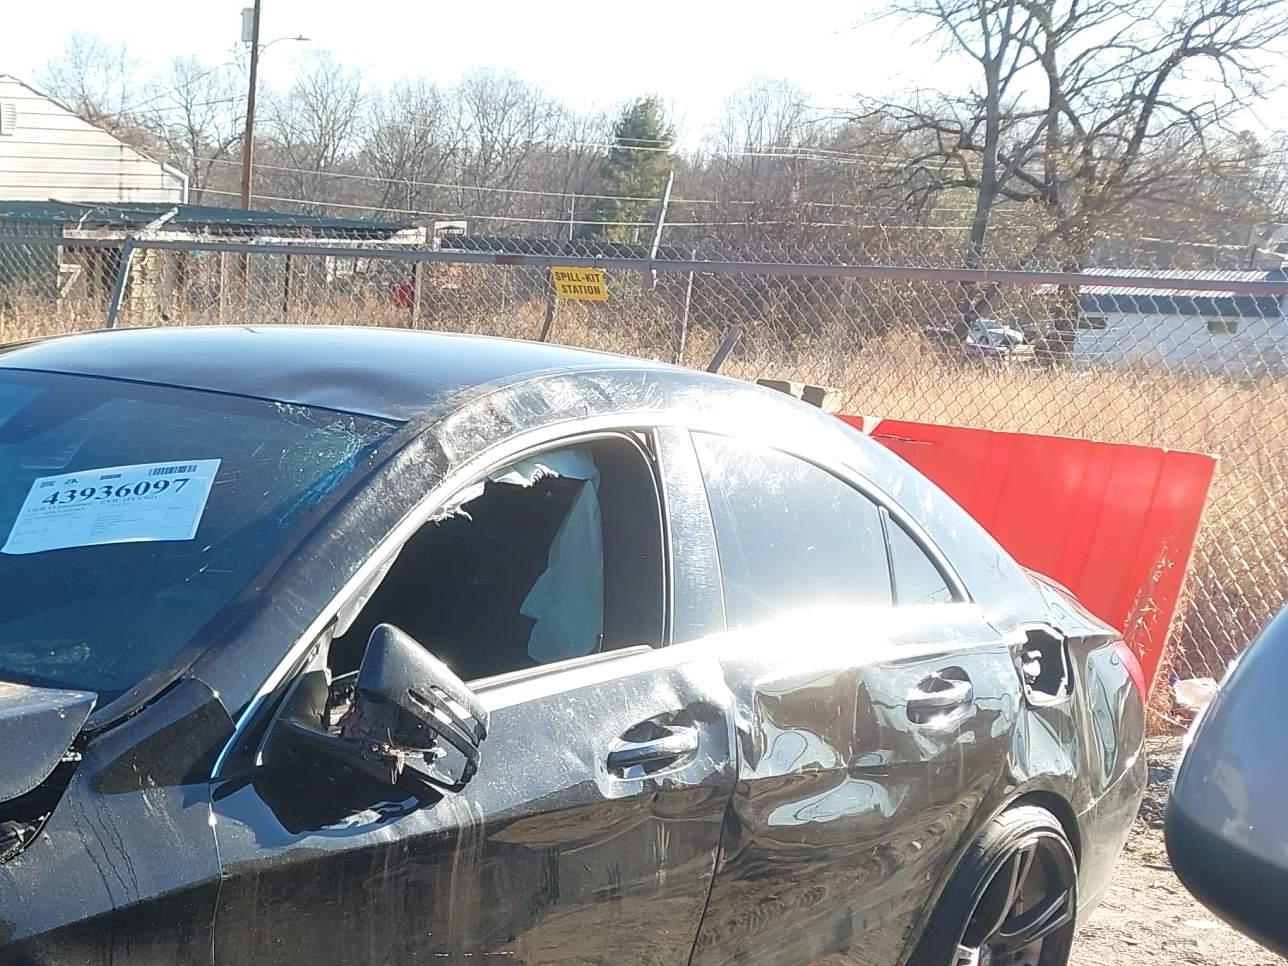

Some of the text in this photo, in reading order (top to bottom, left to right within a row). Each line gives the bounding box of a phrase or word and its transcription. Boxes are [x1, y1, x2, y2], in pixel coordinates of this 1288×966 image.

[555, 271, 600, 283] SPILL-KIT
[561, 285, 601, 295] STATION
[42, 478, 191, 505] 43936097
